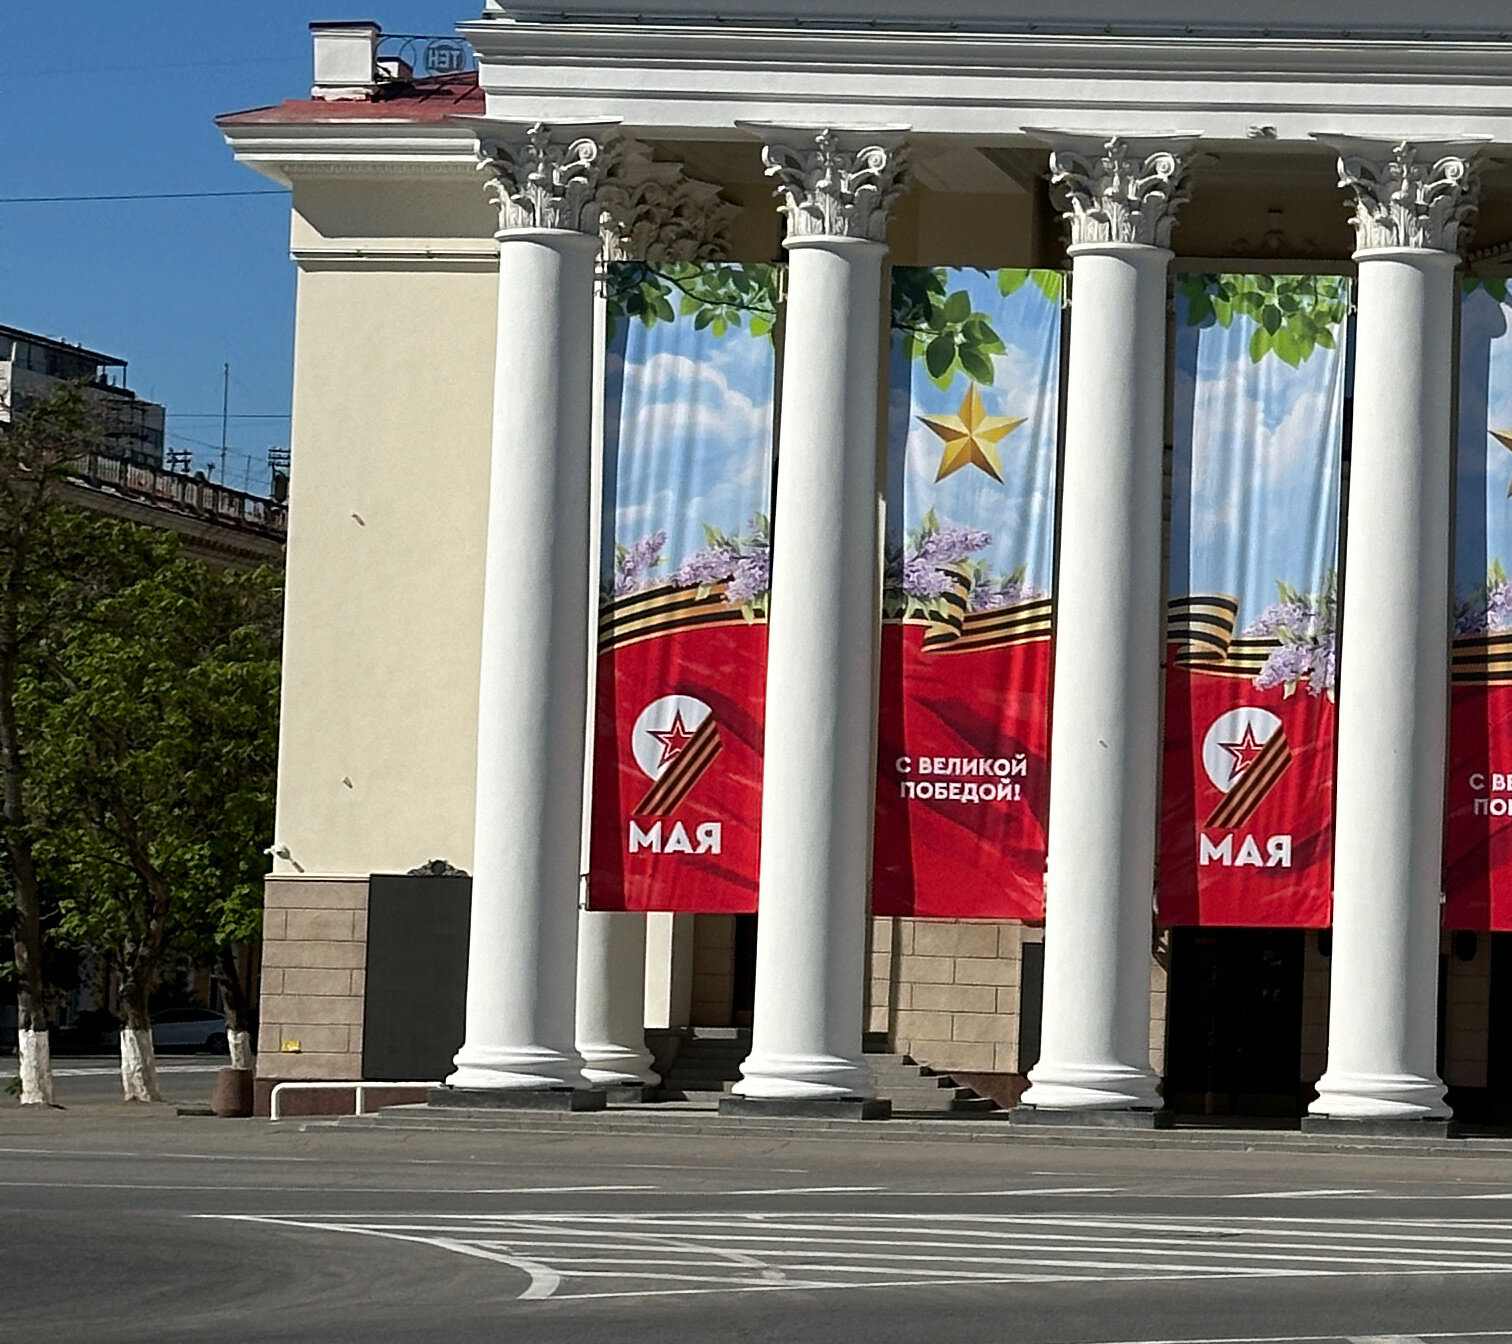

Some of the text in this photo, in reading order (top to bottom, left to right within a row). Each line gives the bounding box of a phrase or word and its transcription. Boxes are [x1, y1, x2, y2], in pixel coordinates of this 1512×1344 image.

[896, 754, 1027, 776] С ВЕЛИКОЙ
[900, 778, 1021, 803] ПОБЕДОЙ!
[1469, 773, 1485, 791] С
[629, 820, 722, 854] МАЯ
[1199, 832, 1292, 867] МАЯ
